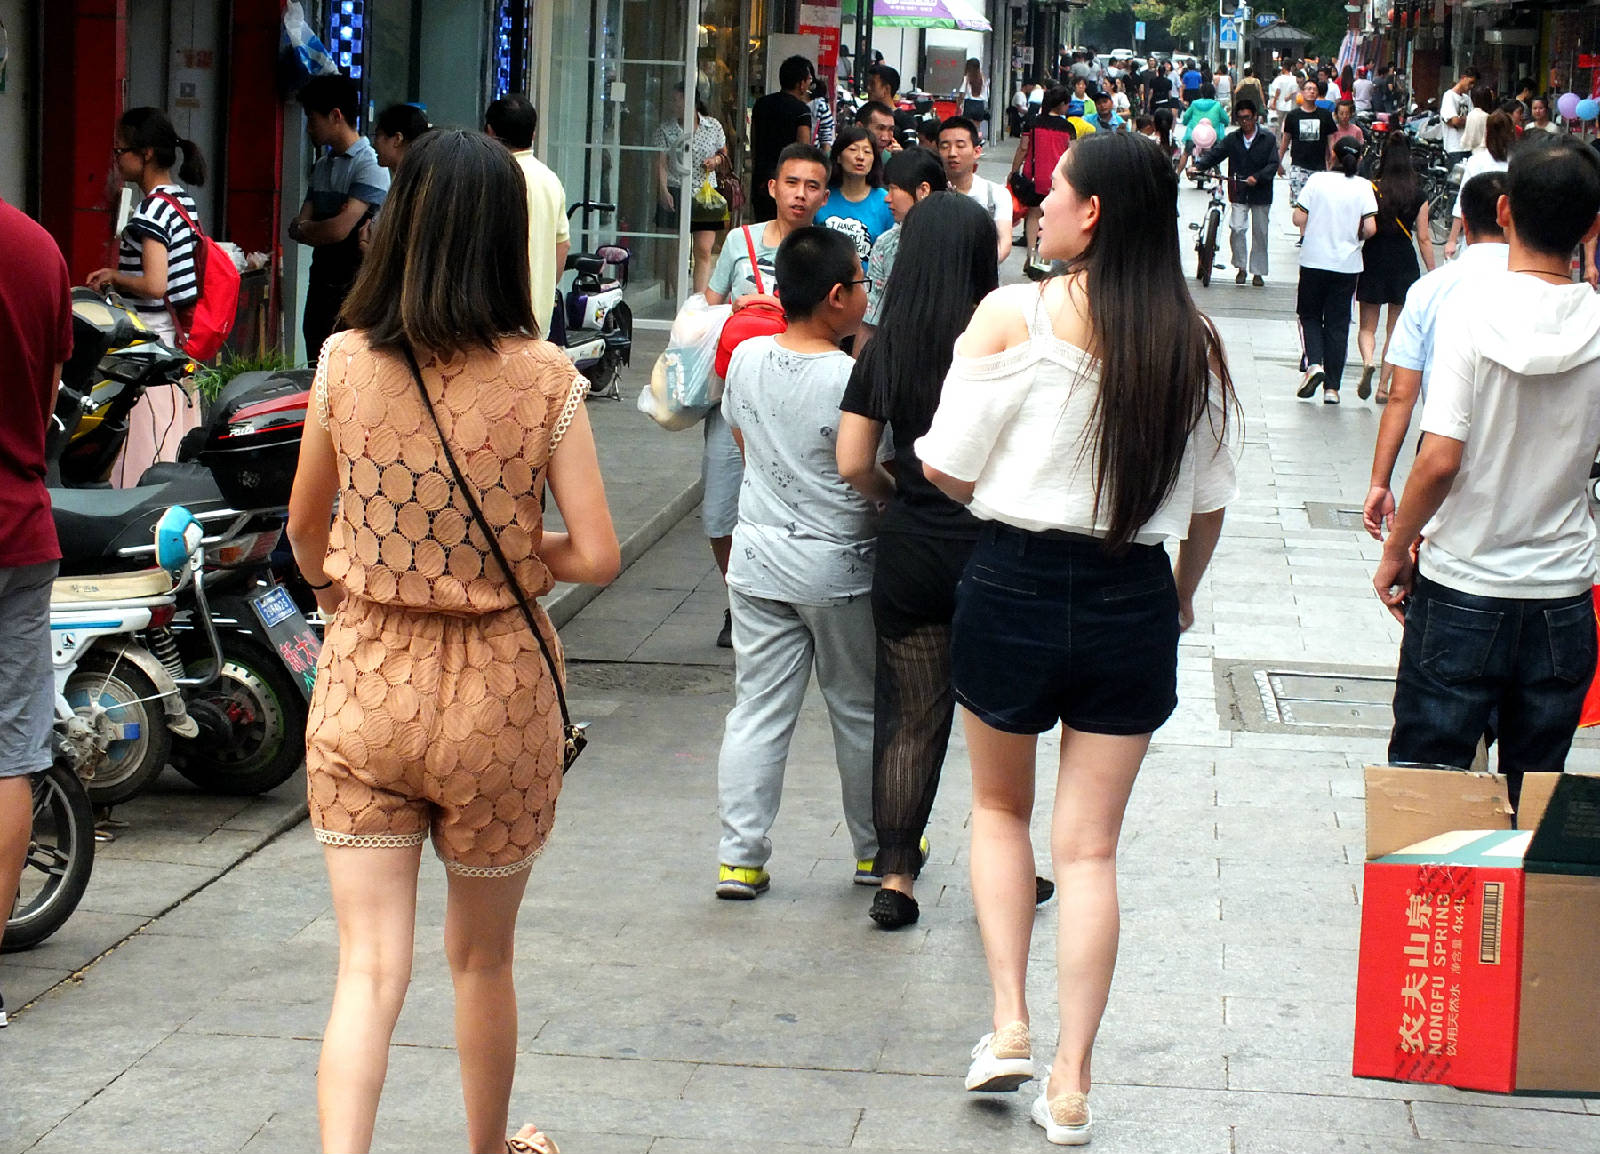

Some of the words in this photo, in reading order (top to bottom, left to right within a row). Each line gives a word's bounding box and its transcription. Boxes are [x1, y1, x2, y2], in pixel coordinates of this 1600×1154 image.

[1433, 893, 1451, 967] SPRING
[1398, 893, 1434, 1054] 农夫山泉
[1428, 976, 1446, 1056] NONGFU
[1446, 983, 1461, 1057] 饮用天然水
